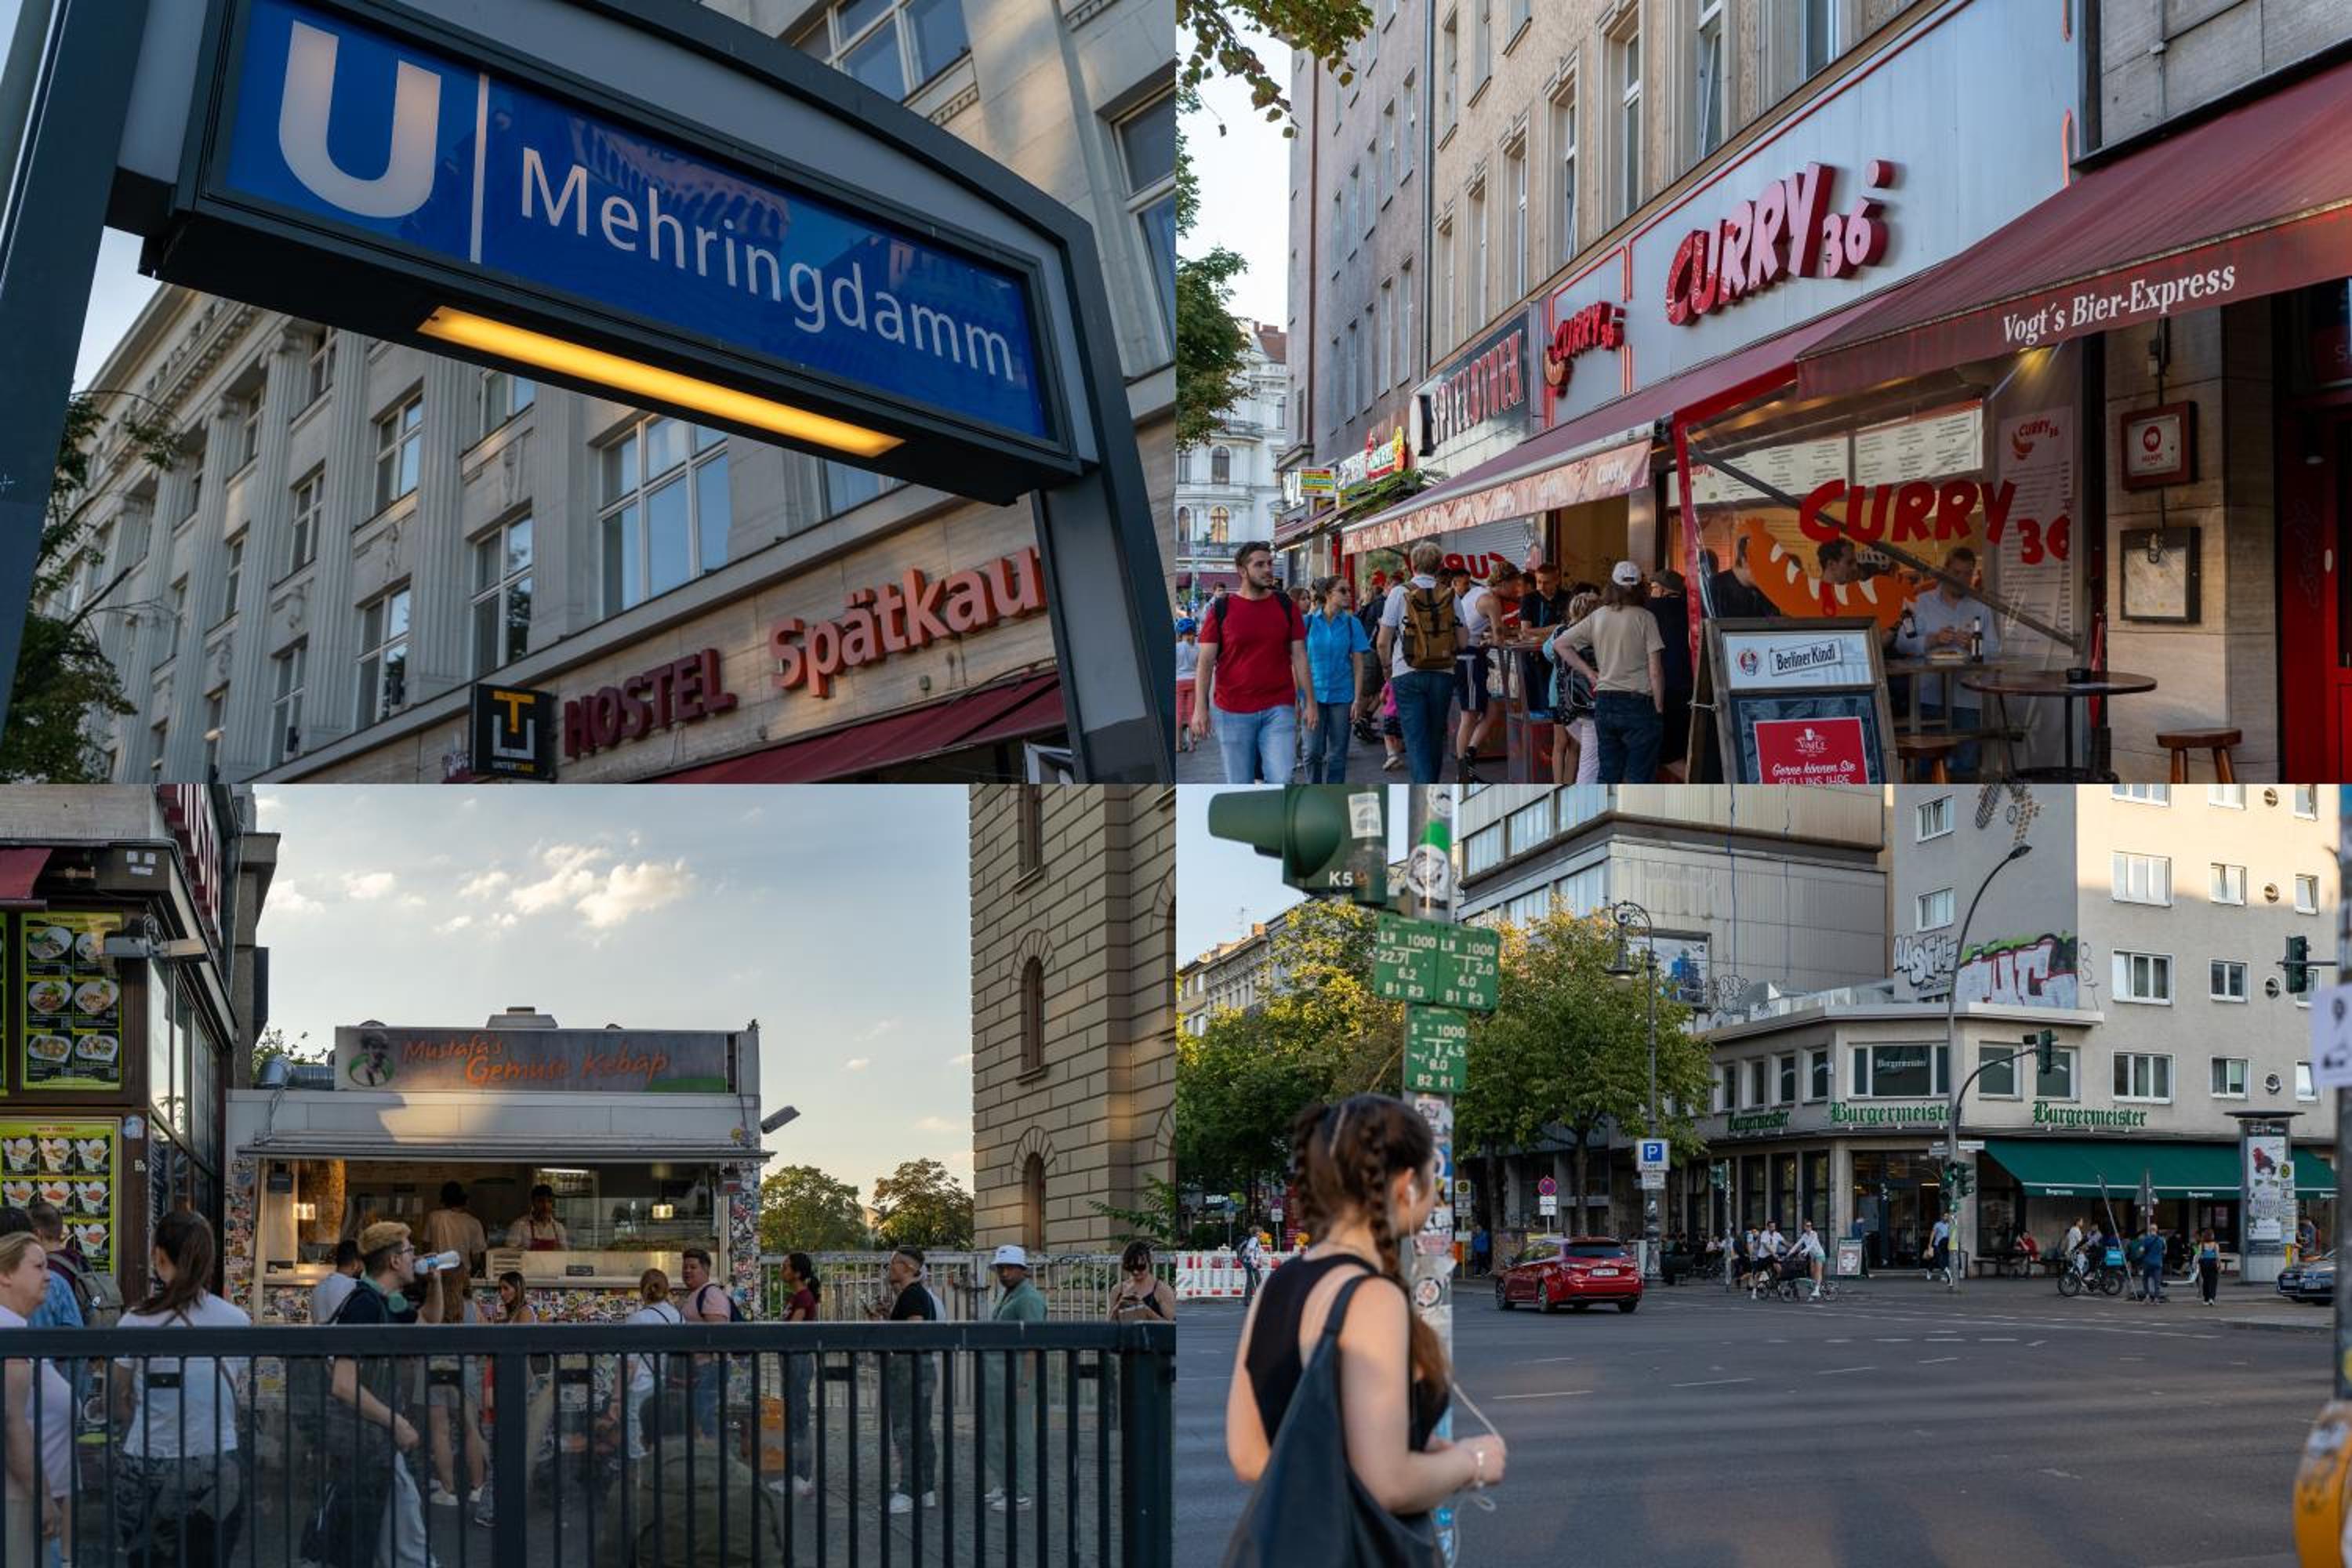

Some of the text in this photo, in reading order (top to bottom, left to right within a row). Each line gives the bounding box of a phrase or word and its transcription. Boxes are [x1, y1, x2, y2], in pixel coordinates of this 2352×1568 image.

[279, 20, 441, 218] U
[1666, 162, 1878, 326] CURRY 36
[521, 147, 1016, 382] Mehringdamm
[2071, 265, 2236, 328] Bier-Express
[1799, 478, 2016, 545] CURRY
[769, 546, 1047, 699] Spätkau
[1776, 643, 1836, 670] Berliner Kindl
[564, 648, 738, 759] HOSTEL
[1773, 763, 1802, 776] Gerne
[1840, 760, 1857, 771] Sie
[1329, 870, 1353, 887] K5
[1407, 934, 1437, 949] 1000
[1467, 943, 1495, 956] 1000
[1475, 963, 1494, 976] 2.0
[1468, 992, 1484, 1005] R3
[1438, 1024, 1466, 1039] 1000
[581, 1040, 669, 1083] Kebap
[2033, 1100, 2147, 1127] Burgermeister
[1648, 1146, 1658, 1159] P
